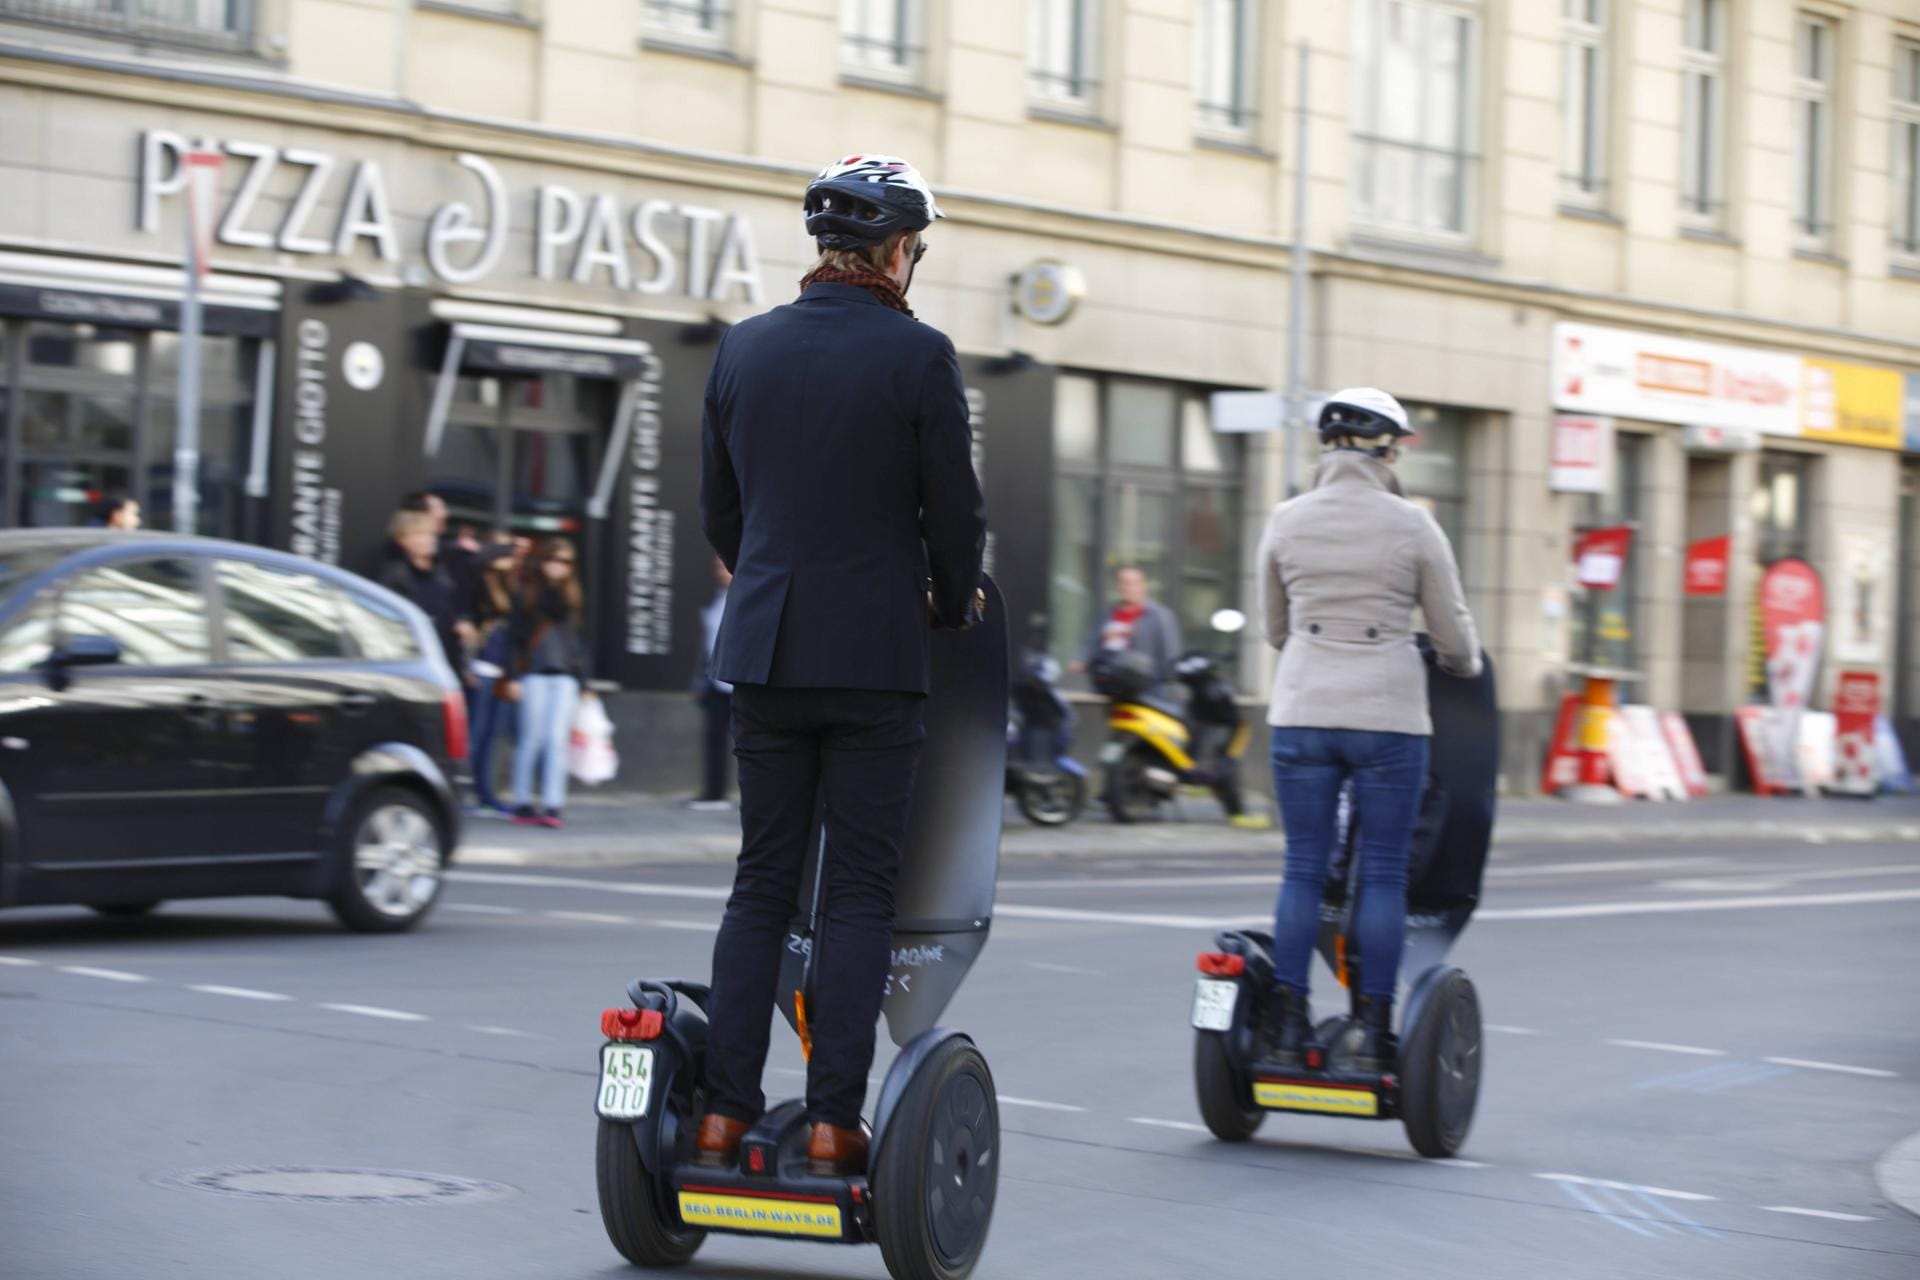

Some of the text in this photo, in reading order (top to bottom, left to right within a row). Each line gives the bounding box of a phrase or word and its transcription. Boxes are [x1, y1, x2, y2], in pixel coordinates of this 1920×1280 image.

[140, 130, 401, 262] PZZA
[537, 185, 764, 304] PASTA
[297, 318, 328, 444] GIOTTO
[627, 476, 658, 654] RISTORANTE
[607, 1052, 647, 1080] 454
